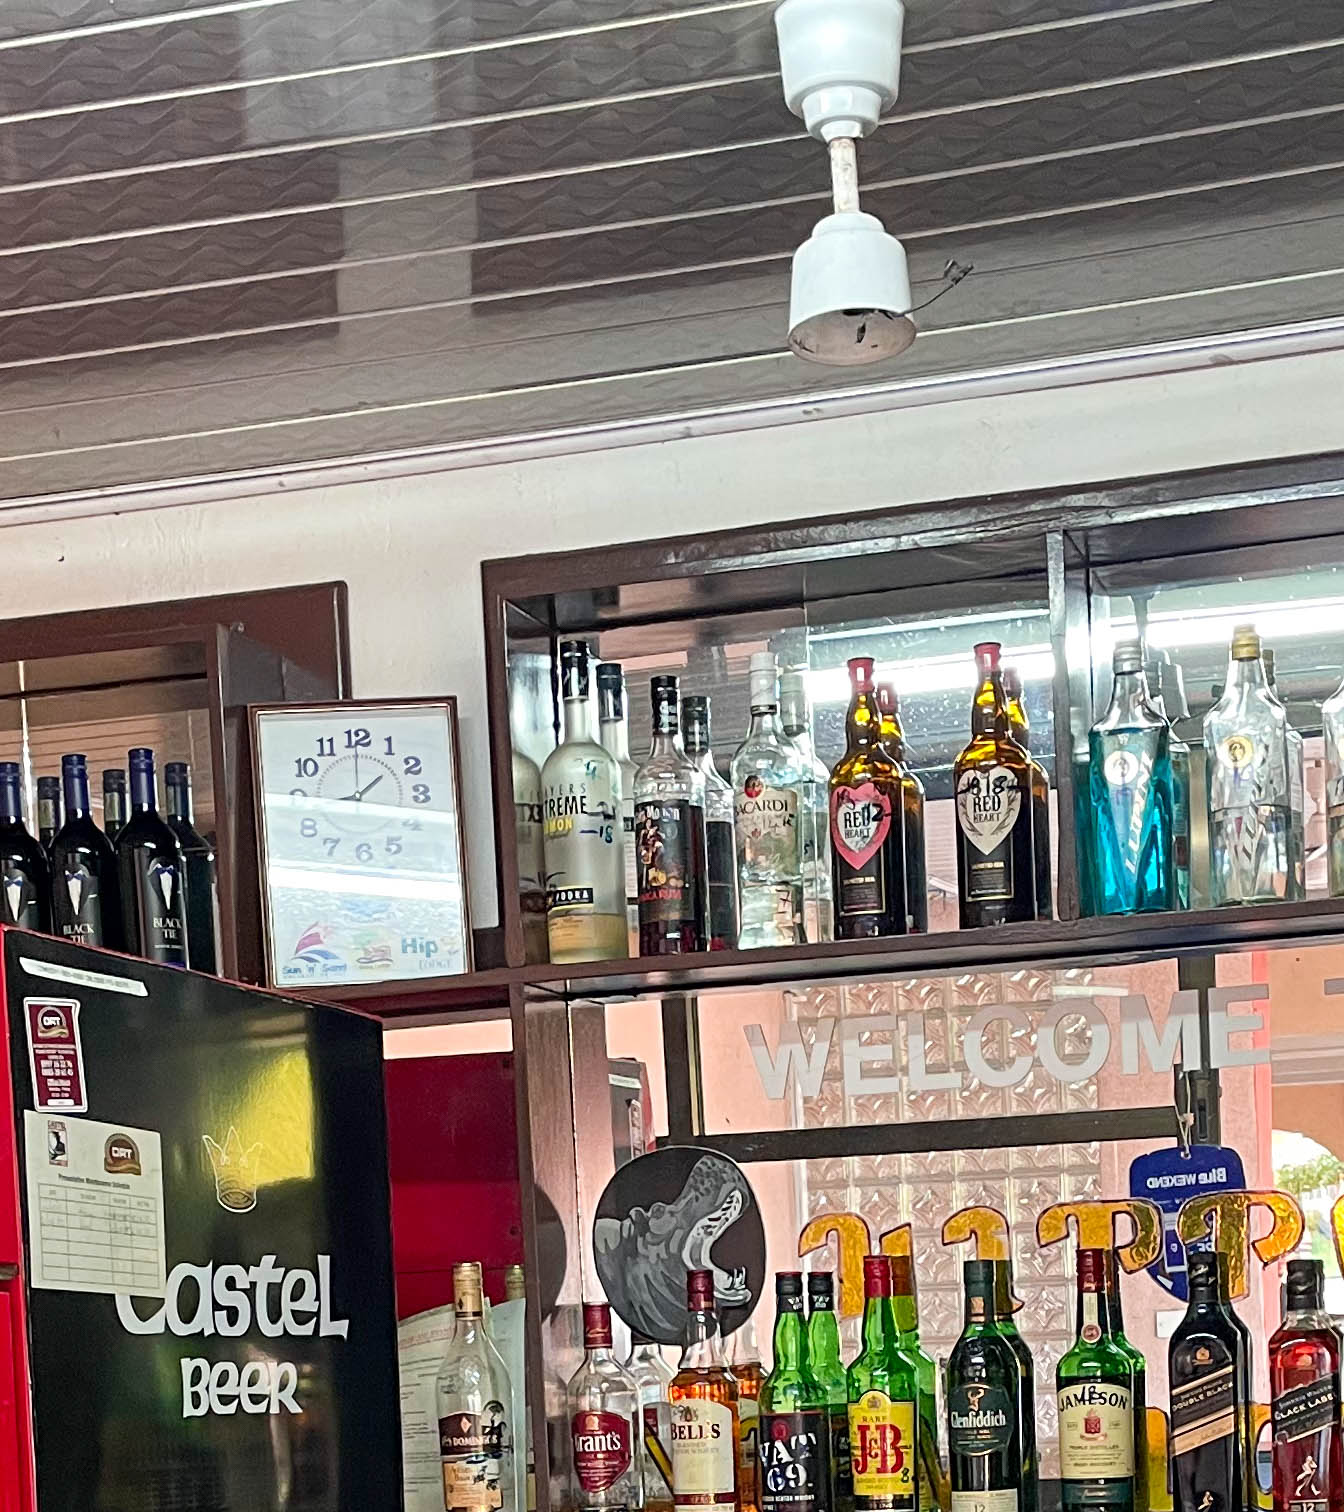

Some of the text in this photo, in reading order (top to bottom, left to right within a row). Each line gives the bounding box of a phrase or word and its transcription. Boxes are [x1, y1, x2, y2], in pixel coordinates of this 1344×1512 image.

[316, 737, 336, 757] 11
[344, 728, 372, 748] 12
[384, 736, 395, 756] 1
[295, 757, 319, 778] 10
[404, 756, 422, 776] 2
[412, 783, 431, 804] 3
[973, 796, 1001, 813] RED
[300, 818, 317, 838] 8
[973, 812, 1002, 824] HEART
[844, 829, 872, 840] HEART
[322, 837, 341, 857] 7
[356, 843, 373, 862] 6
[385, 836, 403, 855] 5
[555, 888, 591, 901] VODKA
[63, 923, 94, 936] BLACK
[153, 917, 183, 930] BLACK
[401, 937, 438, 958] Hip
[743, 984, 1272, 1102] WELCOME
[180, 1356, 303, 1419] BEER
[1059, 1392, 1127, 1412] JAMESON
[951, 1409, 1007, 1429] Glenfiddich
[760, 1432, 818, 1465] VAT
